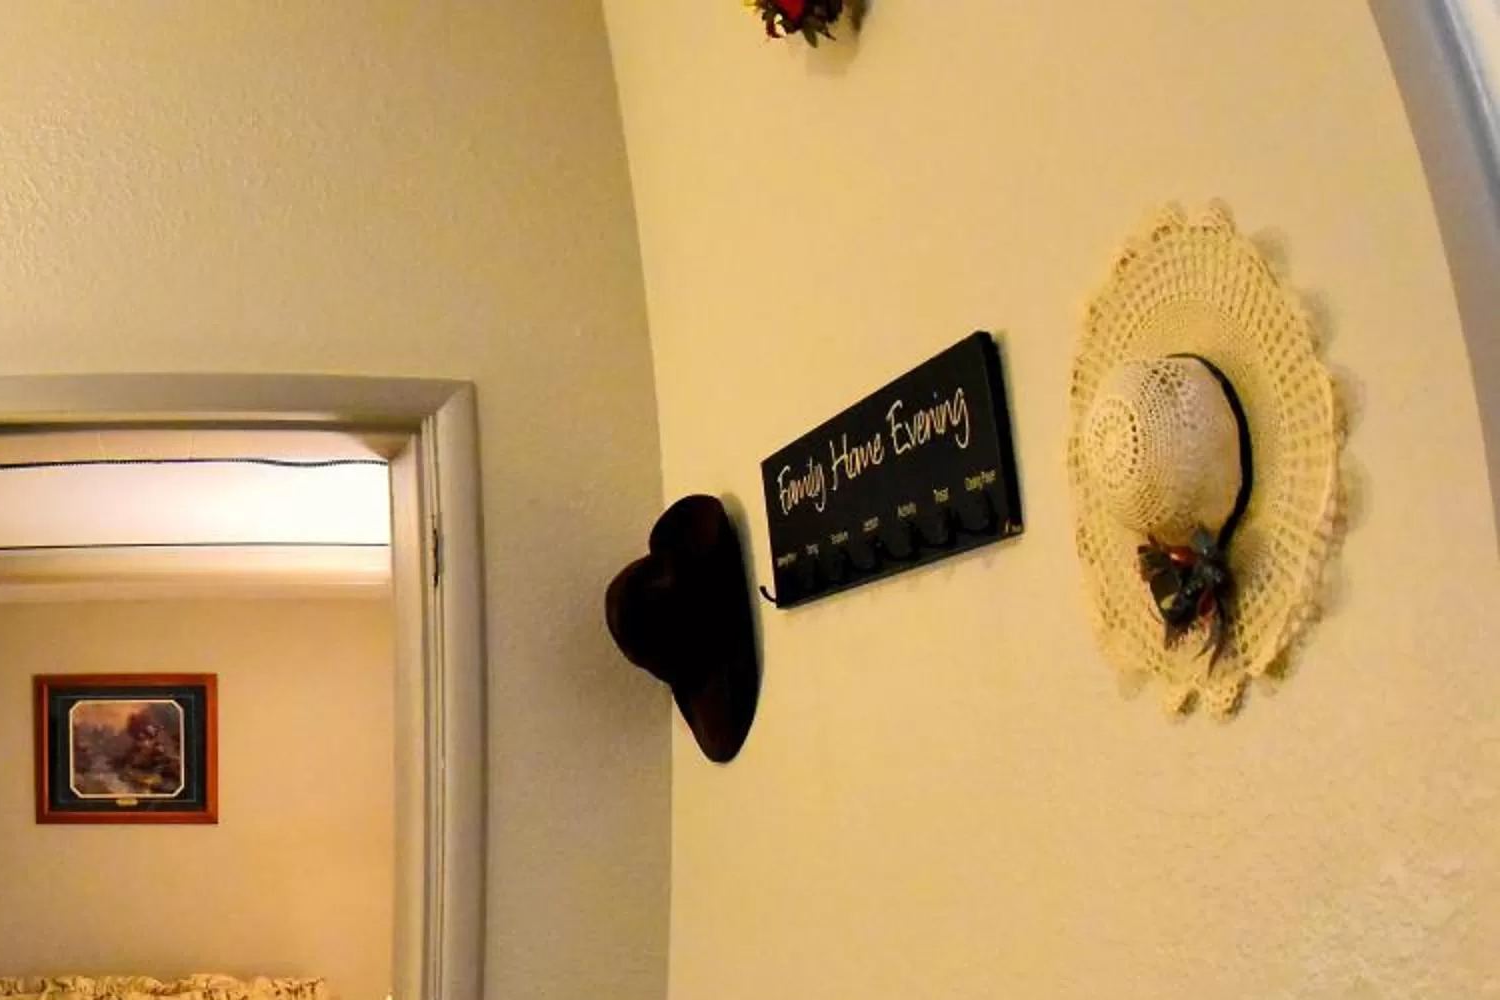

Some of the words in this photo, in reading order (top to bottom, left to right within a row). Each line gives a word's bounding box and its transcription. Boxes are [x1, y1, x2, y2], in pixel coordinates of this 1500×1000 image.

[777, 456, 826, 516] Family
[829, 432, 885, 491] Home
[885, 387, 970, 455] Evening
